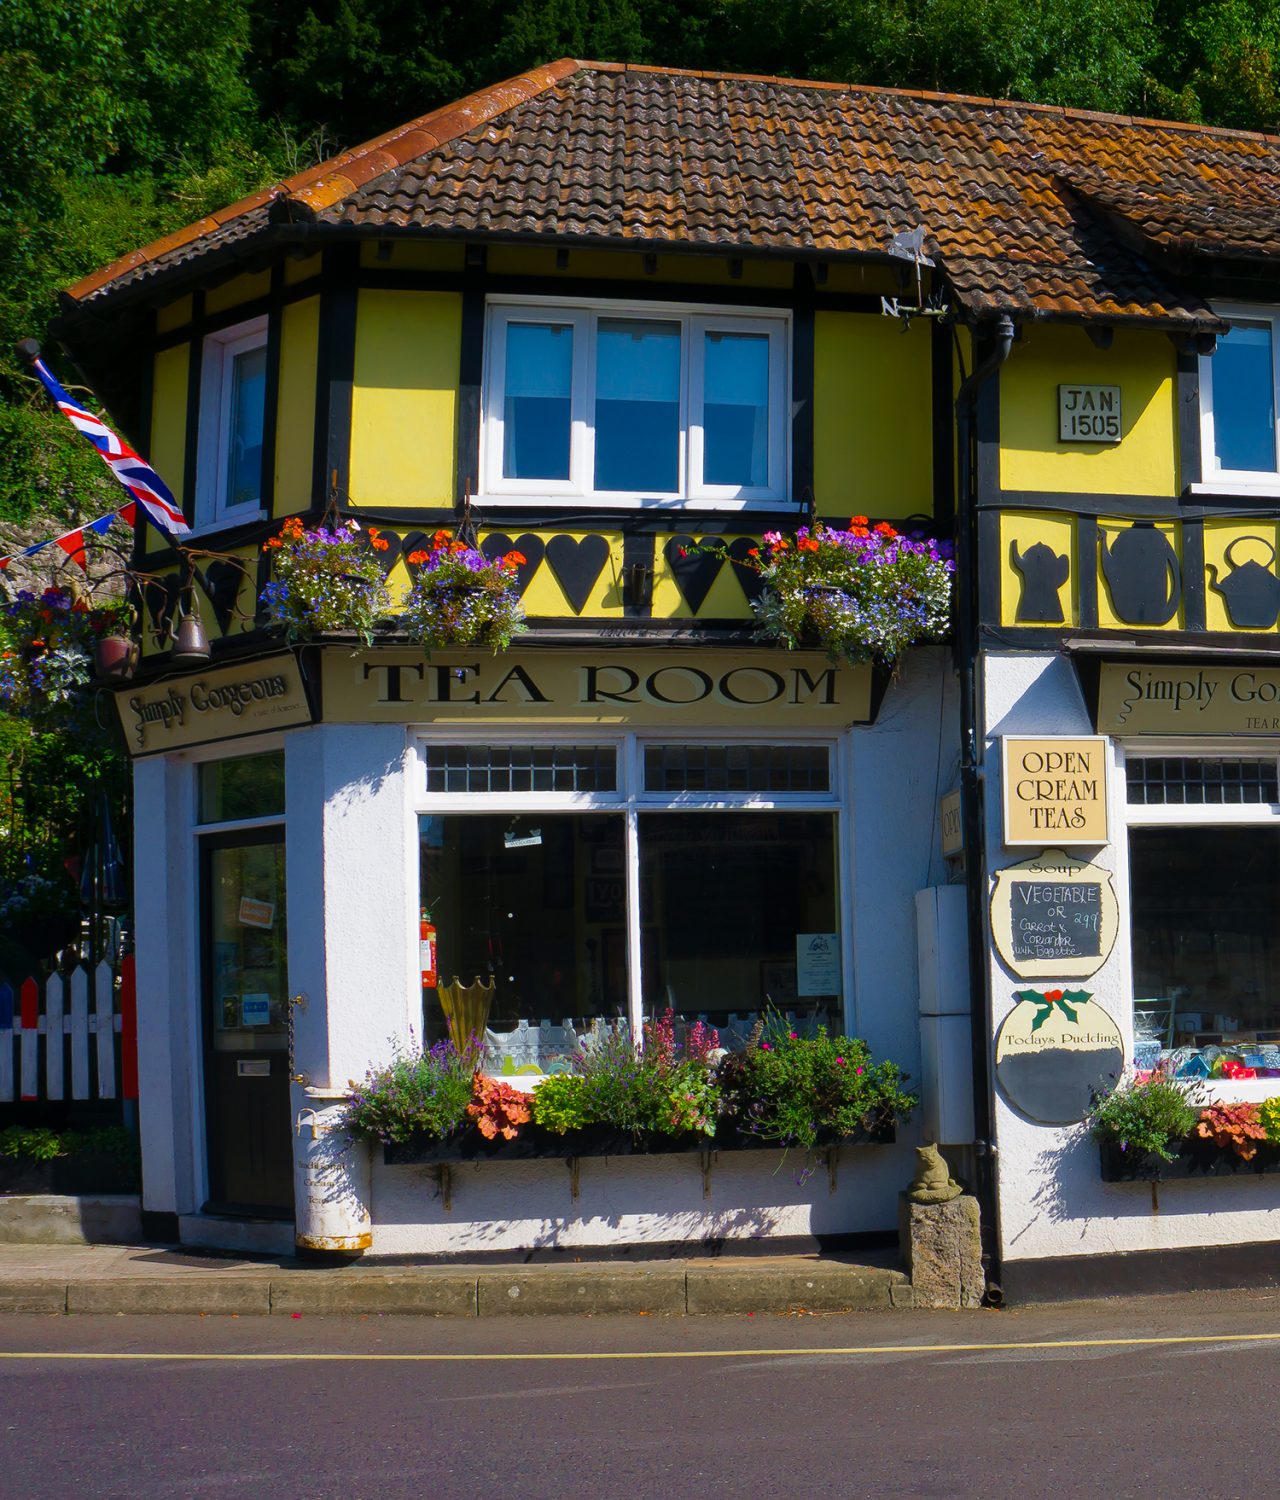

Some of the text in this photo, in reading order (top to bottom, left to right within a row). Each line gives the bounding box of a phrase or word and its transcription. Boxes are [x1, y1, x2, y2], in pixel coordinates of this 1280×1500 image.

[1065, 390, 1113, 412] JAN
[1071, 415, 1119, 436] 1505
[363, 661, 842, 705] TEA ROOM
[1119, 670, 1218, 724] Simply
[129, 674, 288, 749] Simply Gorgeous
[1246, 717, 1272, 729] TEA
[1022, 751, 1091, 773] OPEN
[1016, 779, 1099, 801] CREAM
[1029, 806, 1086, 829] TEAS
[1028, 863, 1081, 877] Soup
[1019, 885, 1098, 904] VEGETABLE
[1005, 1033, 1119, 1047] Todays Pudding
